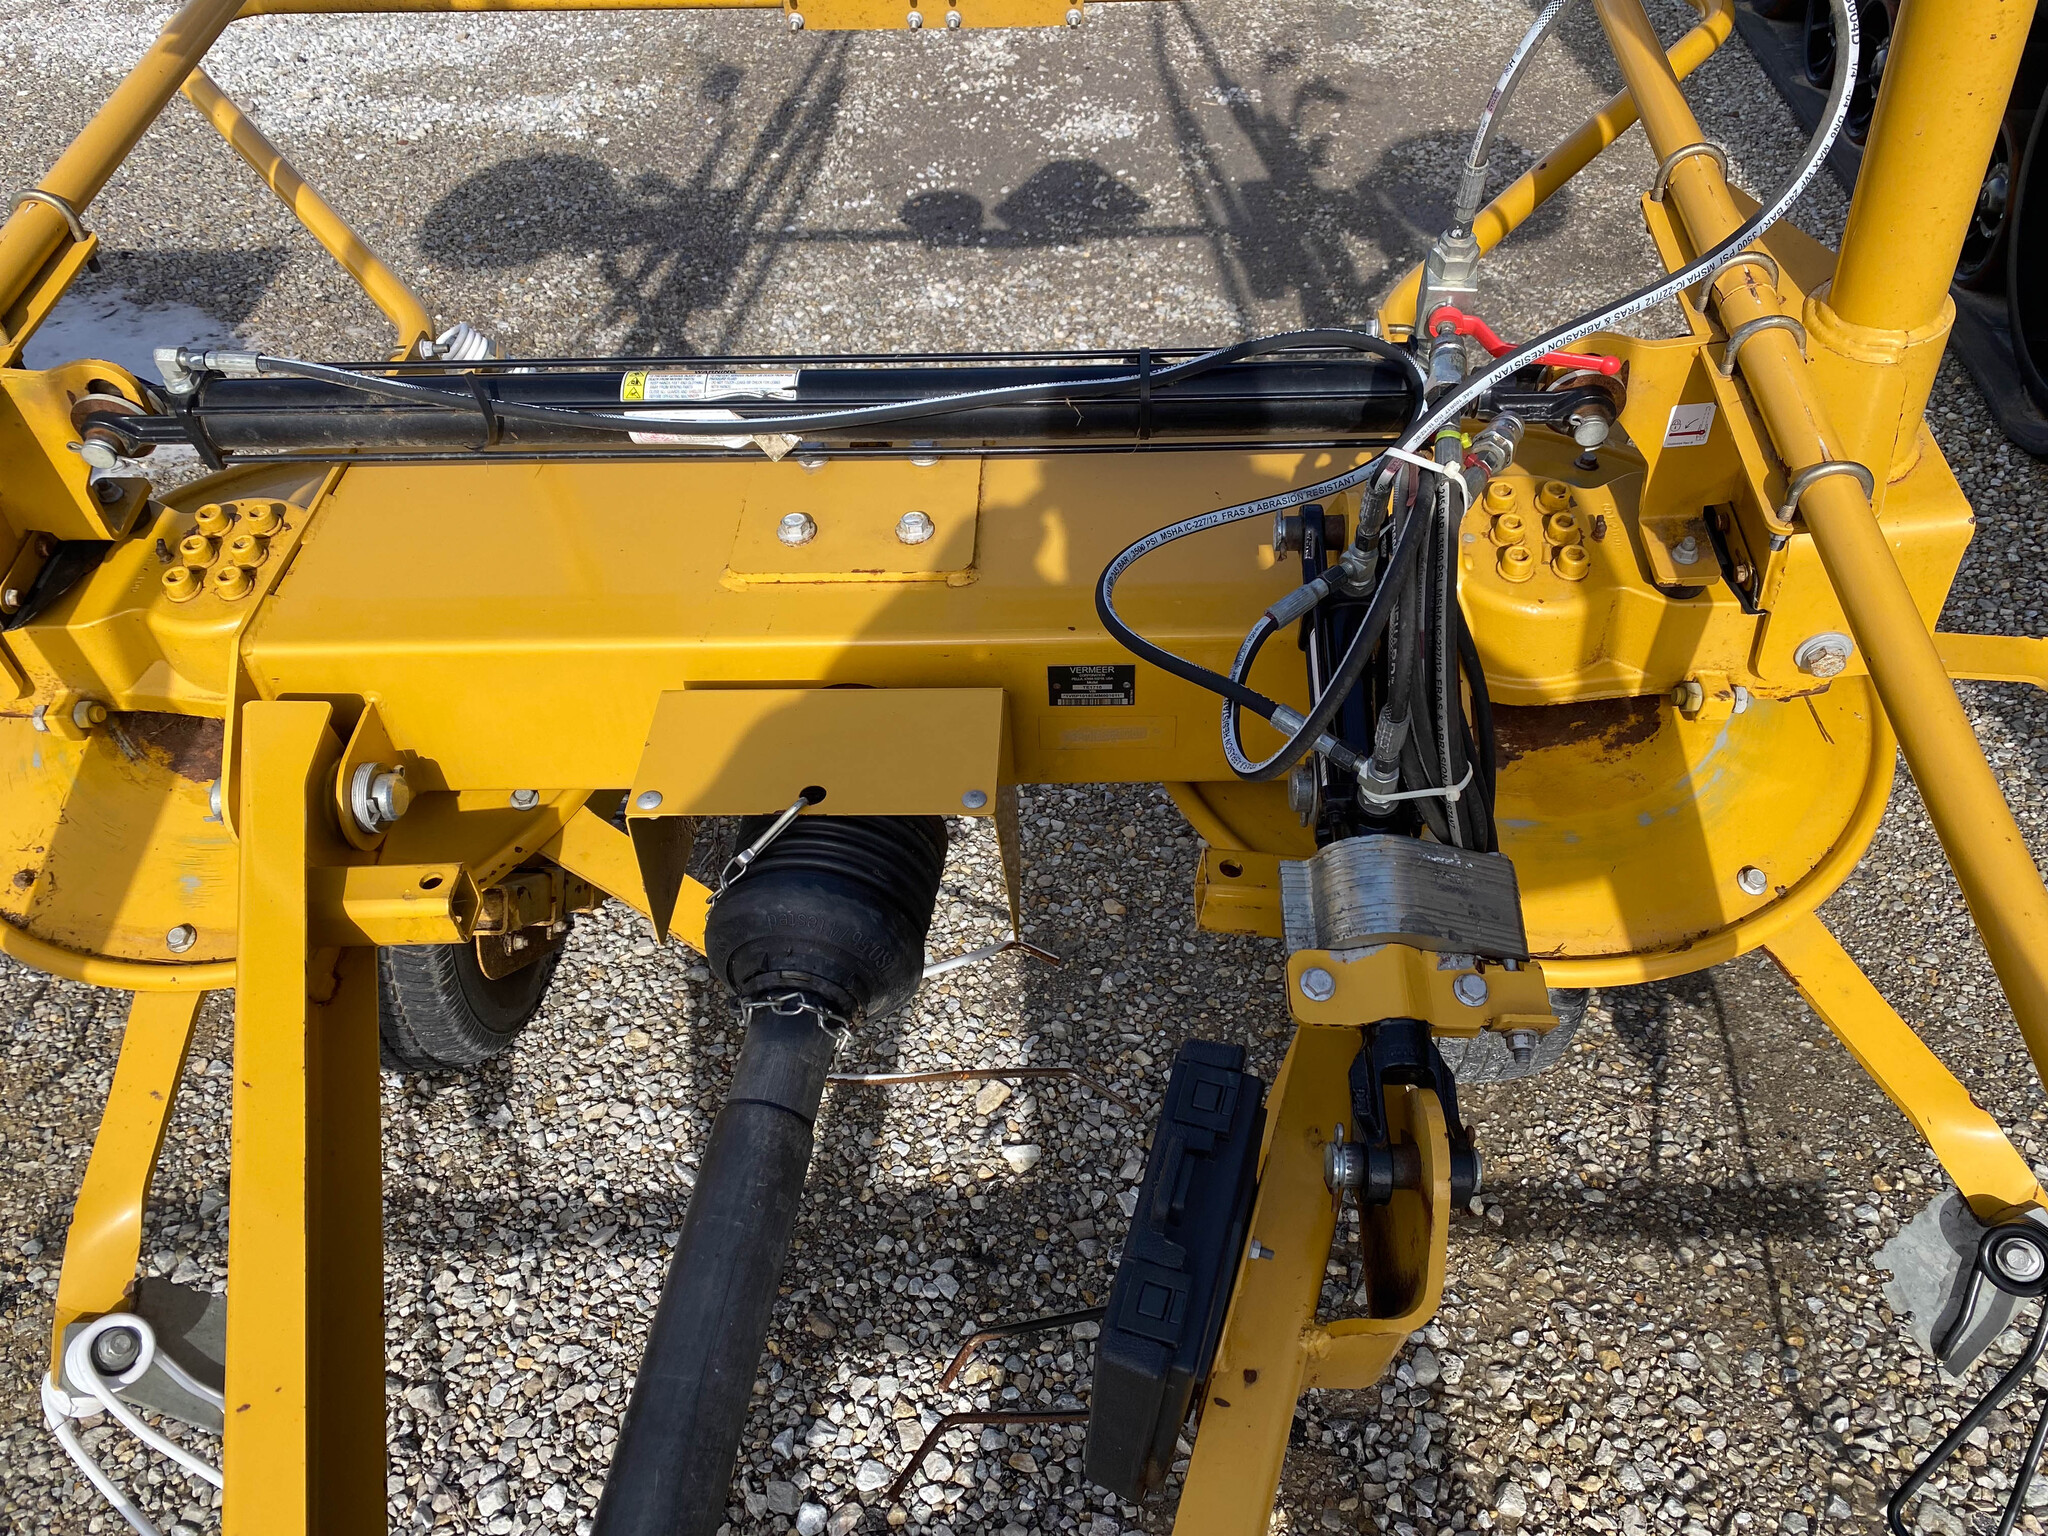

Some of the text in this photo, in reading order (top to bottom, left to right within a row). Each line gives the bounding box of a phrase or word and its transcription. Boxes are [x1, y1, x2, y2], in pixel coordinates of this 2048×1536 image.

[1844, 0, 1860, 45] 004D
[1850, 62, 1858, 78] 1/4
[1830, 114, 1845, 138] DN6
[1812, 144, 1830, 168] MAX
[1801, 172, 1814, 189] WP
[1785, 188, 1800, 206] 245
[1764, 207, 1784, 228] BAR
[1738, 230, 1758, 252] 3500
[1718, 250, 1736, 265] PSI
[1688, 264, 1716, 285] MSHA
[1645, 282, 1687, 306] IC-227/12
[1604, 316, 1611, 326] &
[1614, 303, 1641, 321] FRAS
[1548, 321, 1601, 351] ABRASION
[1489, 349, 1545, 385] RESISTANT
[1117, 556, 1130, 571] BAR
[1131, 544, 1146, 557] 3500
[1145, 536, 1159, 549] PSI
[1161, 526, 1184, 541] MSHA
[1184, 515, 1218, 532] IC-227/12
[1222, 507, 1246, 521] FRAS
[1248, 506, 1254, 514] &
[1257, 492, 1304, 513] ABRASION
[1305, 475, 1356, 499] RESISTANT
[1069, 666, 1115, 674] VERMEER
